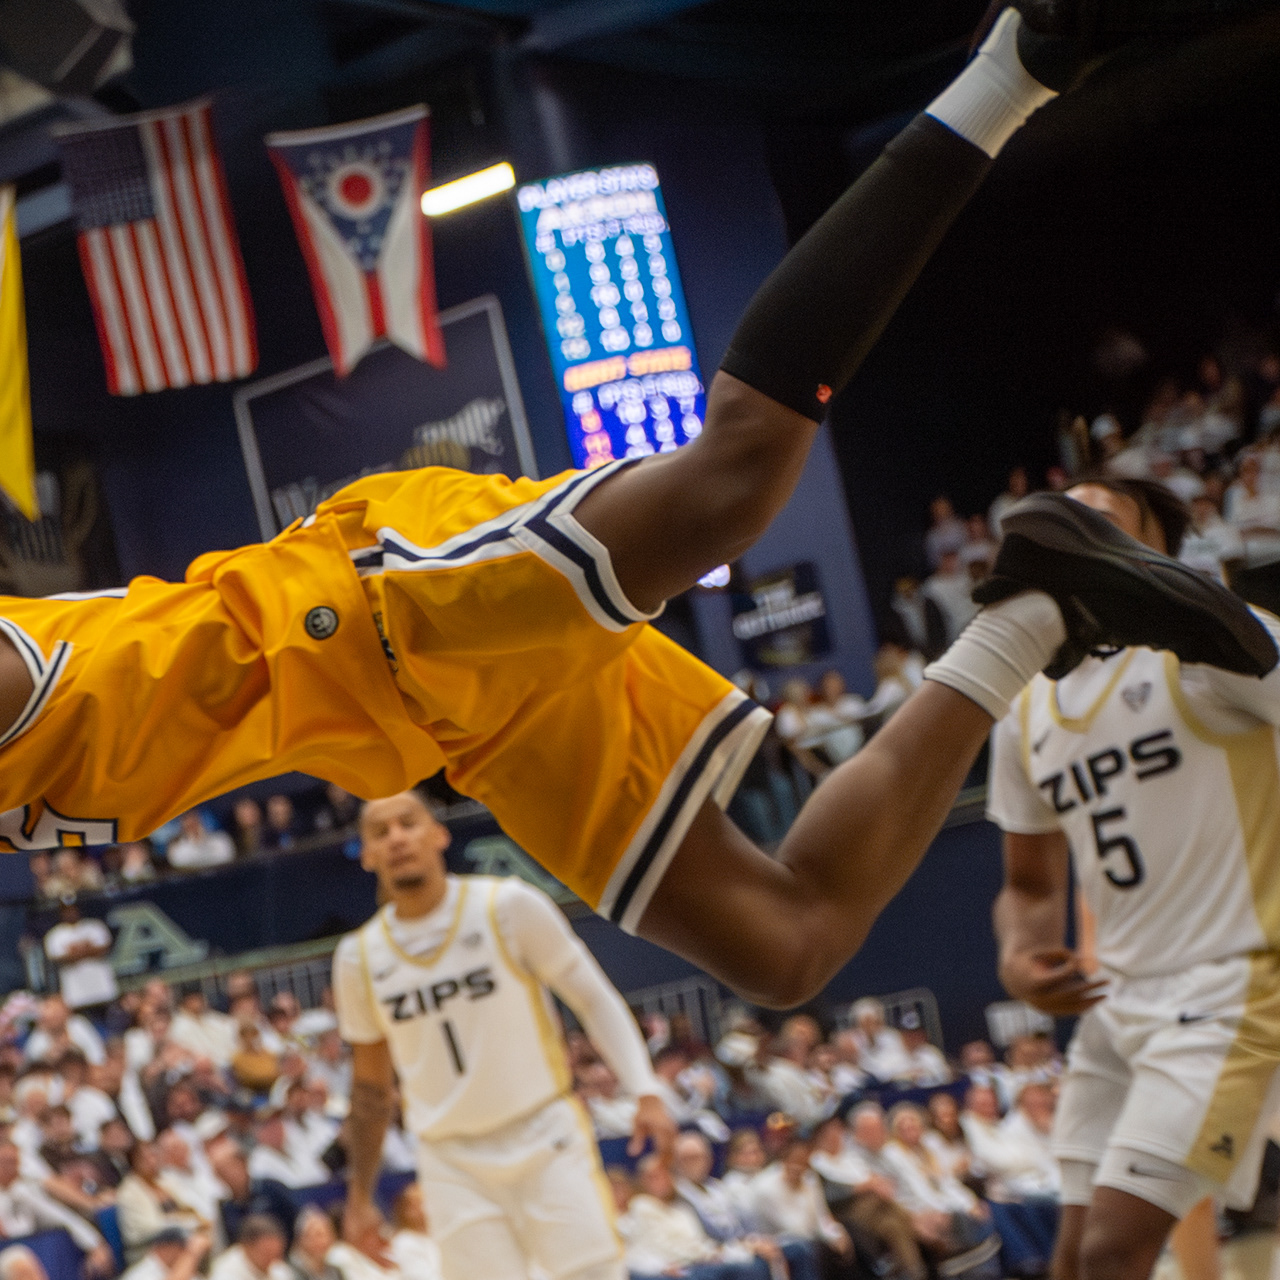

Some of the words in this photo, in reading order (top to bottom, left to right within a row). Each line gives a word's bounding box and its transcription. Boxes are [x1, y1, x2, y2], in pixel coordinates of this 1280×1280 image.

[1038, 727, 1183, 816] ZIPS
[1091, 805, 1146, 892] 5
[383, 966, 497, 1022] ZIPS
[442, 1020, 466, 1076] 1
